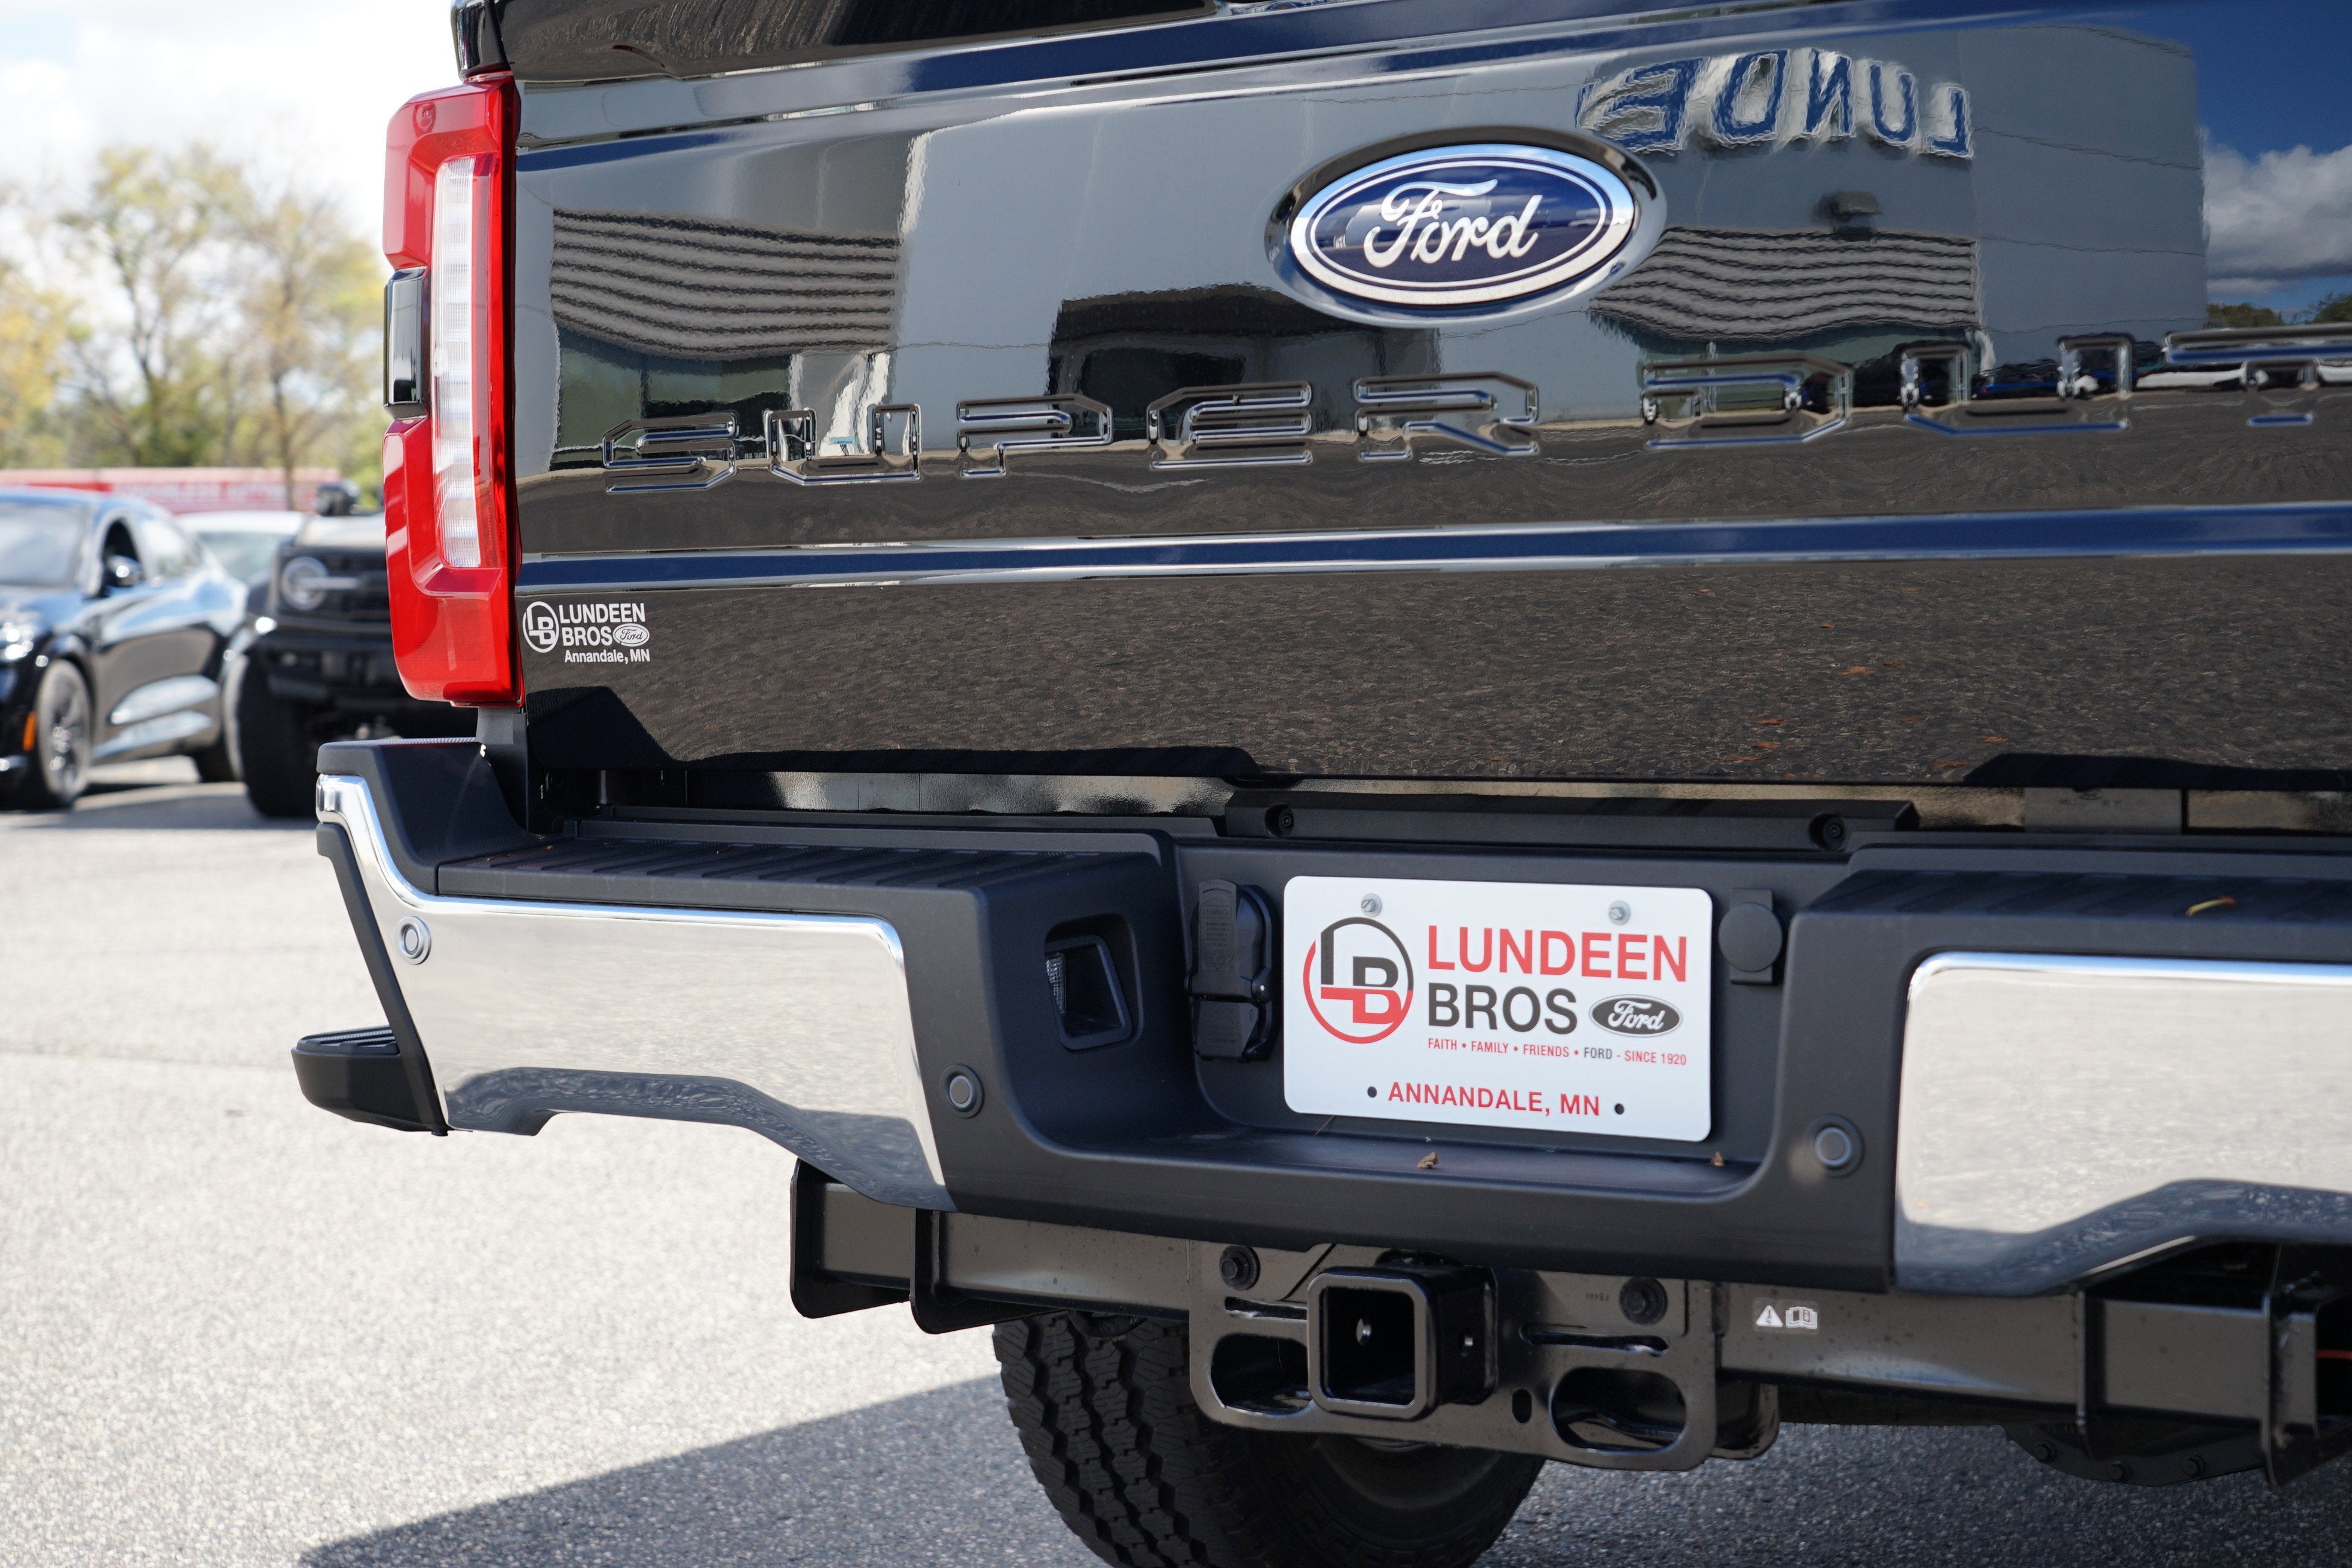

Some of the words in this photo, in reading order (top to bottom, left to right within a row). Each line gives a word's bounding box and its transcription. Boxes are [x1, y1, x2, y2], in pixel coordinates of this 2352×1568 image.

[1364, 179, 1544, 268] Ford
[602, 372, 1538, 494] SUPER
[559, 603, 645, 623] LUNDEEN
[562, 626, 612, 646] BROS
[565, 650, 628, 664] Annandale,
[630, 649, 650, 662] MN
[1428, 925, 1687, 982] LUNDEEN
[1428, 982, 1578, 1035] BROS
[1607, 1000, 1665, 1030] Ford
[1429, 1039, 1457, 1050] FAITH
[1472, 1041, 1508, 1053] FAMILY
[1524, 1045, 1569, 1057] FRIENDS
[1584, 1048, 1612, 1059] FORD
[1625, 1051, 1656, 1062] SINCE
[1662, 1054, 1686, 1065] 1920
[1388, 1082, 1550, 1116] ANNANDALE,
[1561, 1094, 1598, 1116] MN
